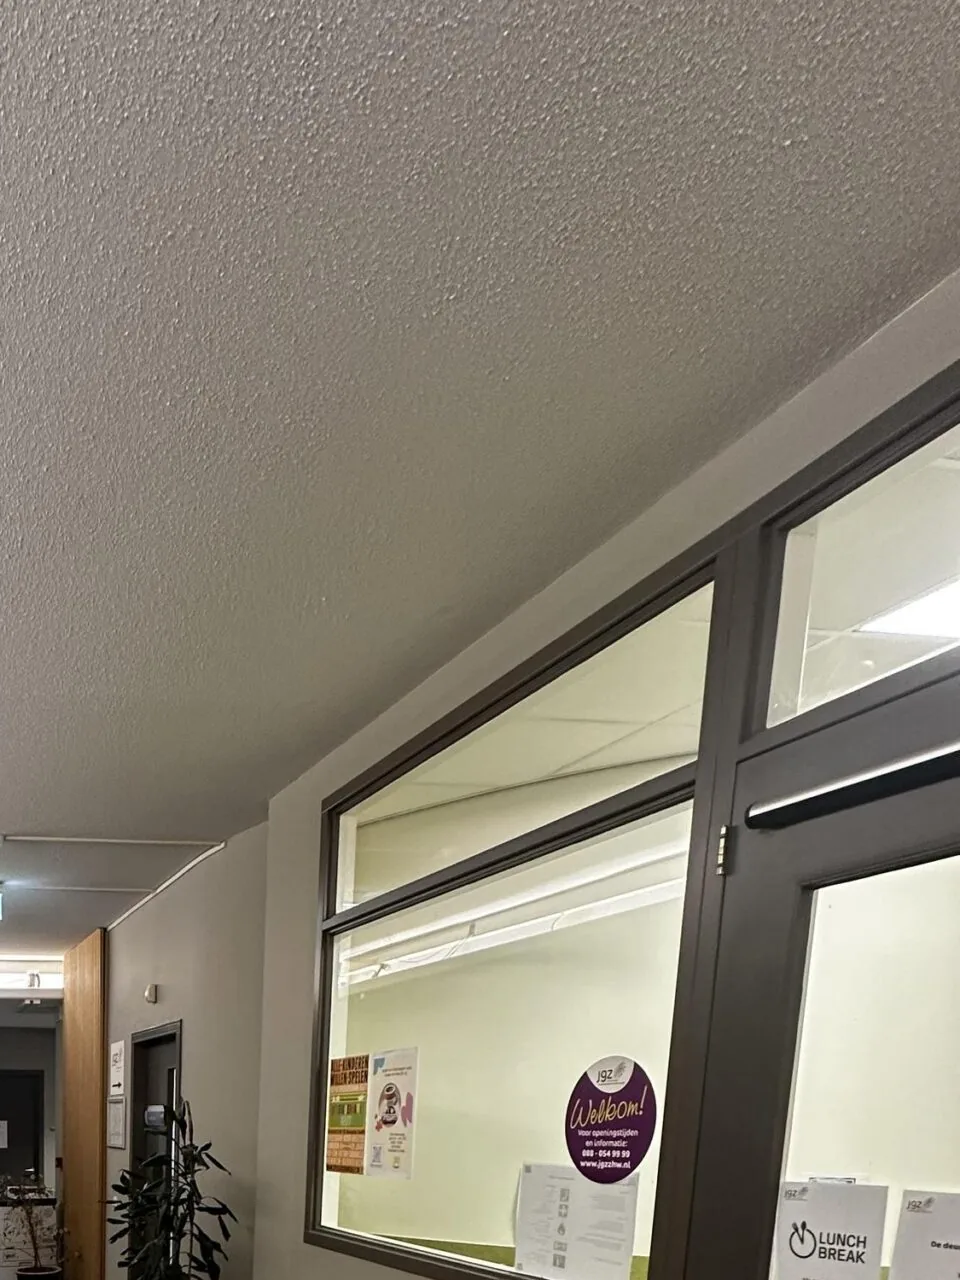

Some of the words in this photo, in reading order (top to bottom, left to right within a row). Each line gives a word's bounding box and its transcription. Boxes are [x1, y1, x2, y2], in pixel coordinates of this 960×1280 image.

[570, 1084, 647, 1129] Welkom!
[592, 1128, 639, 1138] openingstijden
[594, 1139, 628, 1147] informatie:
[819, 1232, 867, 1249] LUNCH
[818, 1248, 865, 1264] BREAK
